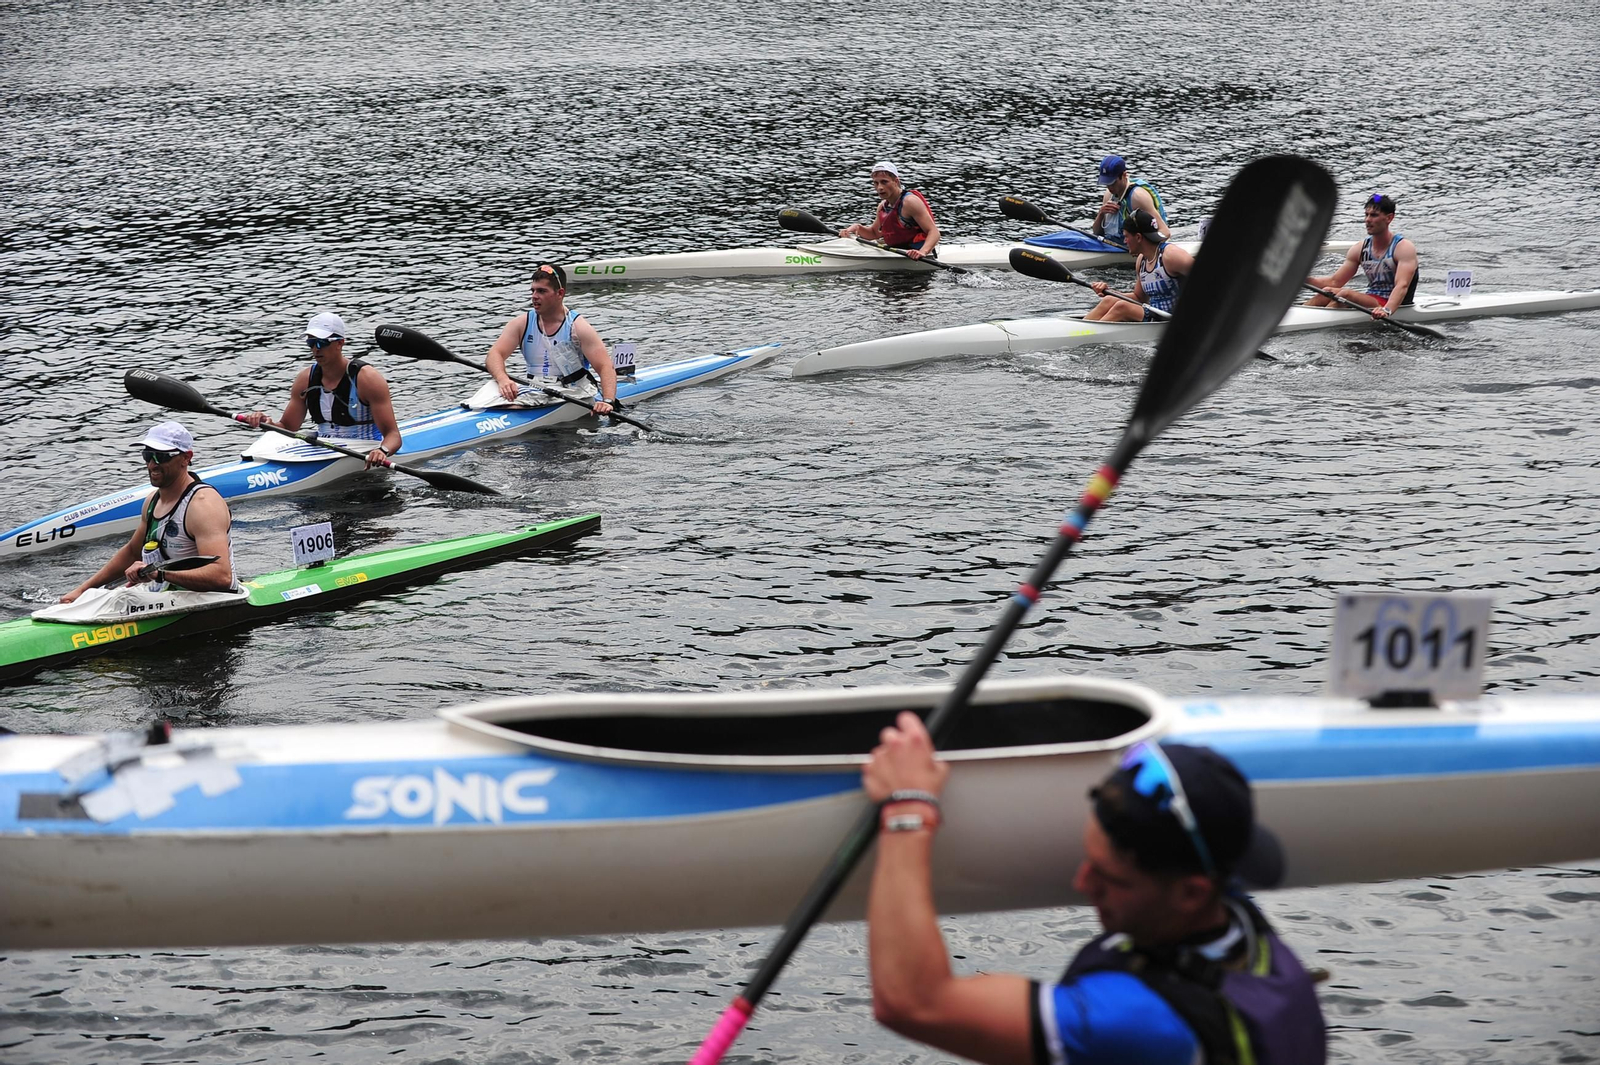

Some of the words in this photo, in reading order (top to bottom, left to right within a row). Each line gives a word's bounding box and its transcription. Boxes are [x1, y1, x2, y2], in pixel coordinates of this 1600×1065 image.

[574, 265, 626, 274] ELIO
[785, 255, 823, 265] SONIC
[1449, 277, 1471, 288] 1002
[614, 353, 634, 365] 1012
[475, 414, 512, 434] SONIC
[246, 467, 288, 489] SONIC
[63, 512, 79, 523] CLUB
[79, 505, 98, 517] NAVAL
[15, 524, 76, 548] ELIO
[298, 532, 333, 555] 1906
[71, 621, 139, 649] FUSION
[1354, 624, 1476, 671] 1011
[343, 765, 559, 827] SONIC
